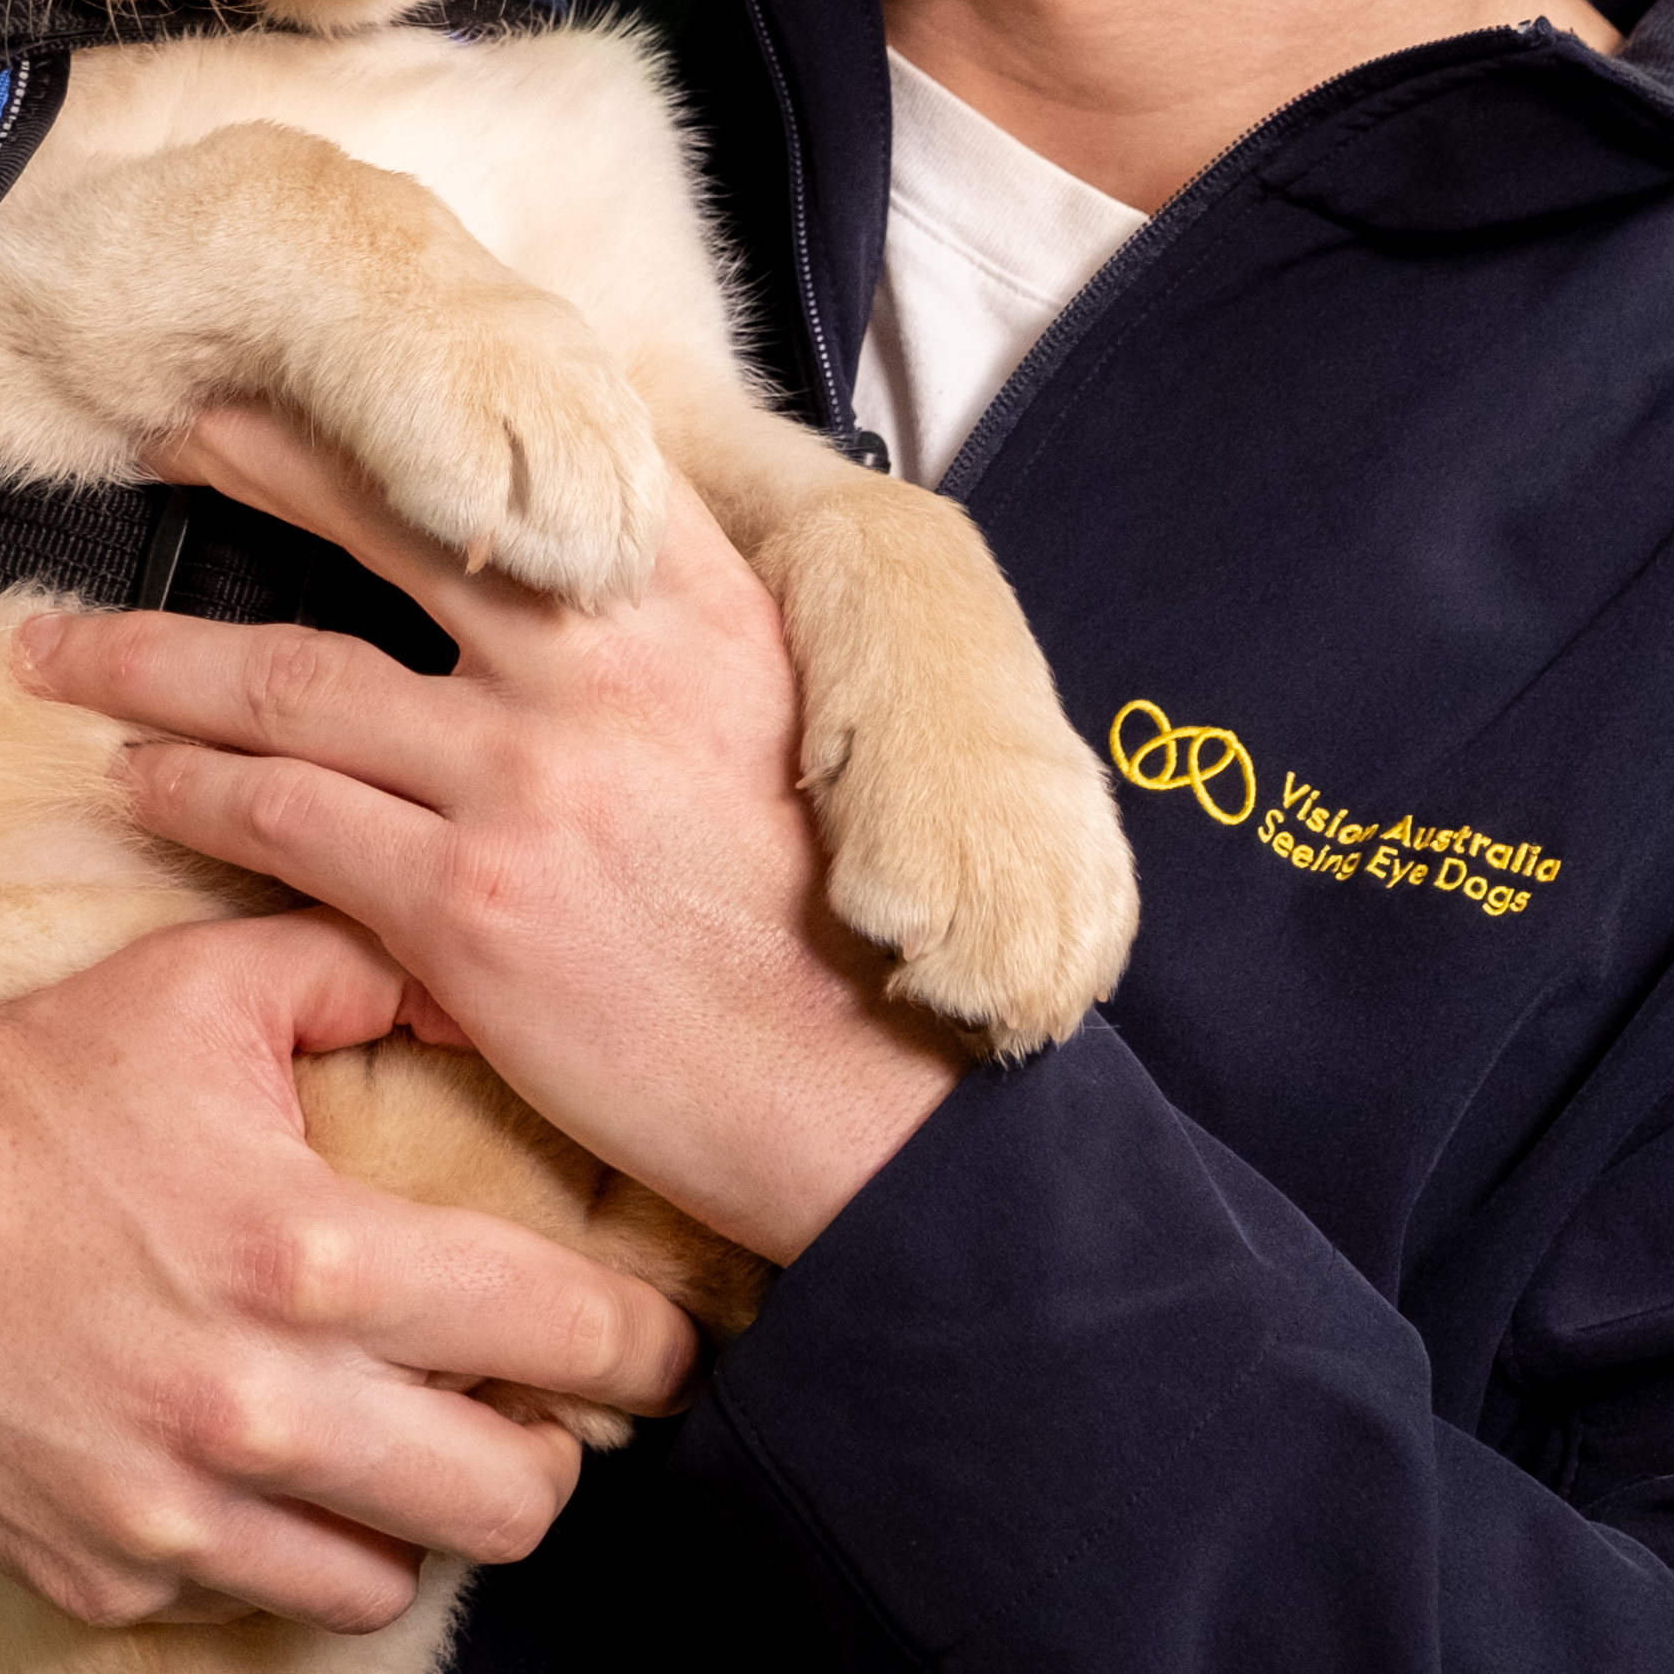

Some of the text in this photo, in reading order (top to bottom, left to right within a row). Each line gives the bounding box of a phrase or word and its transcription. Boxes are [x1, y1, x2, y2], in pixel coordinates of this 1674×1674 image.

[1257, 809, 1532, 916] Seeing Eye Dogs
[1282, 771, 1562, 882] Vision Australia
